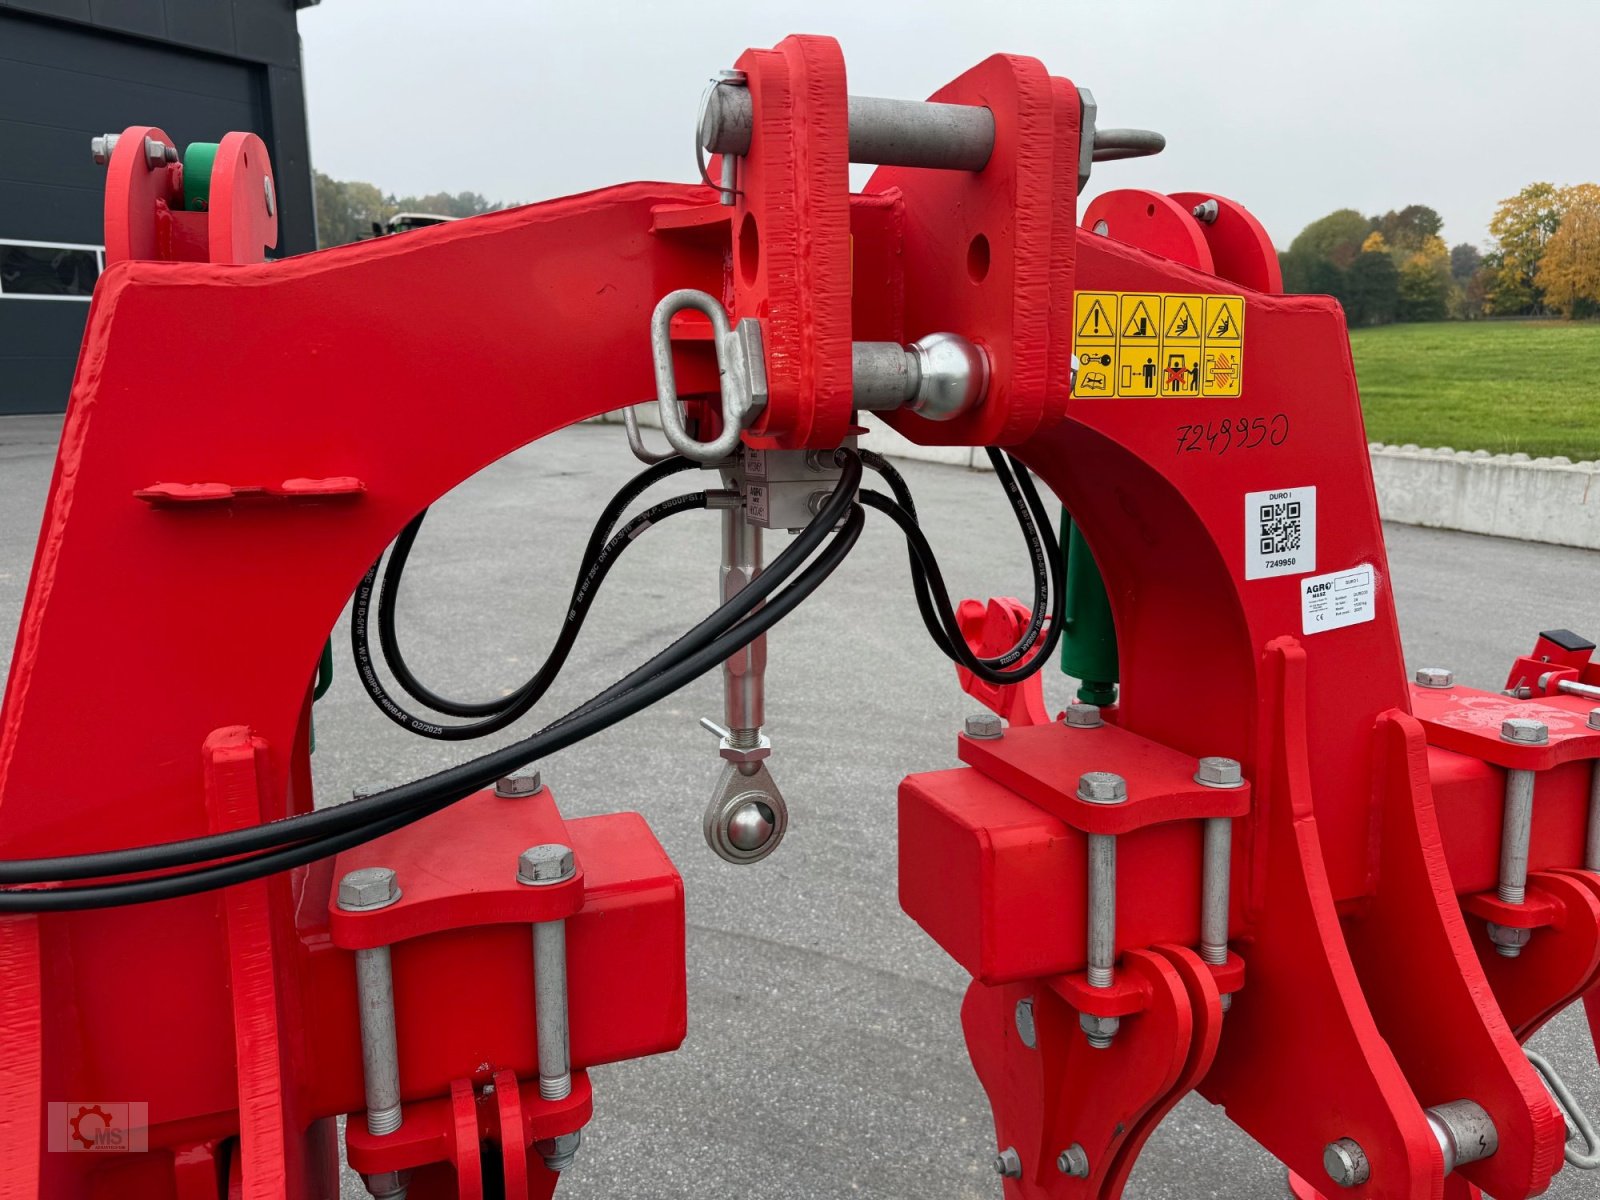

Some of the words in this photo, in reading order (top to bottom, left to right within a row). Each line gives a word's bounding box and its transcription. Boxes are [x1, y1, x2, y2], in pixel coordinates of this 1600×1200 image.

[1176, 413, 1289, 455] 7249950
[1269, 492, 1288, 501] DURO
[1017, 499, 1025, 510] EN
[1265, 557, 1296, 569] 7249950
[576, 590, 585, 603] EN
[588, 563, 599, 579] 2SC
[1306, 581, 1332, 594] AGRO
[361, 587, 370, 599] DN
[1312, 591, 1326, 599] MASZ
[363, 665, 381, 695] 5800PSI
[381, 697, 408, 722] 400BAR
[411, 720, 443, 735] Q2/2025
